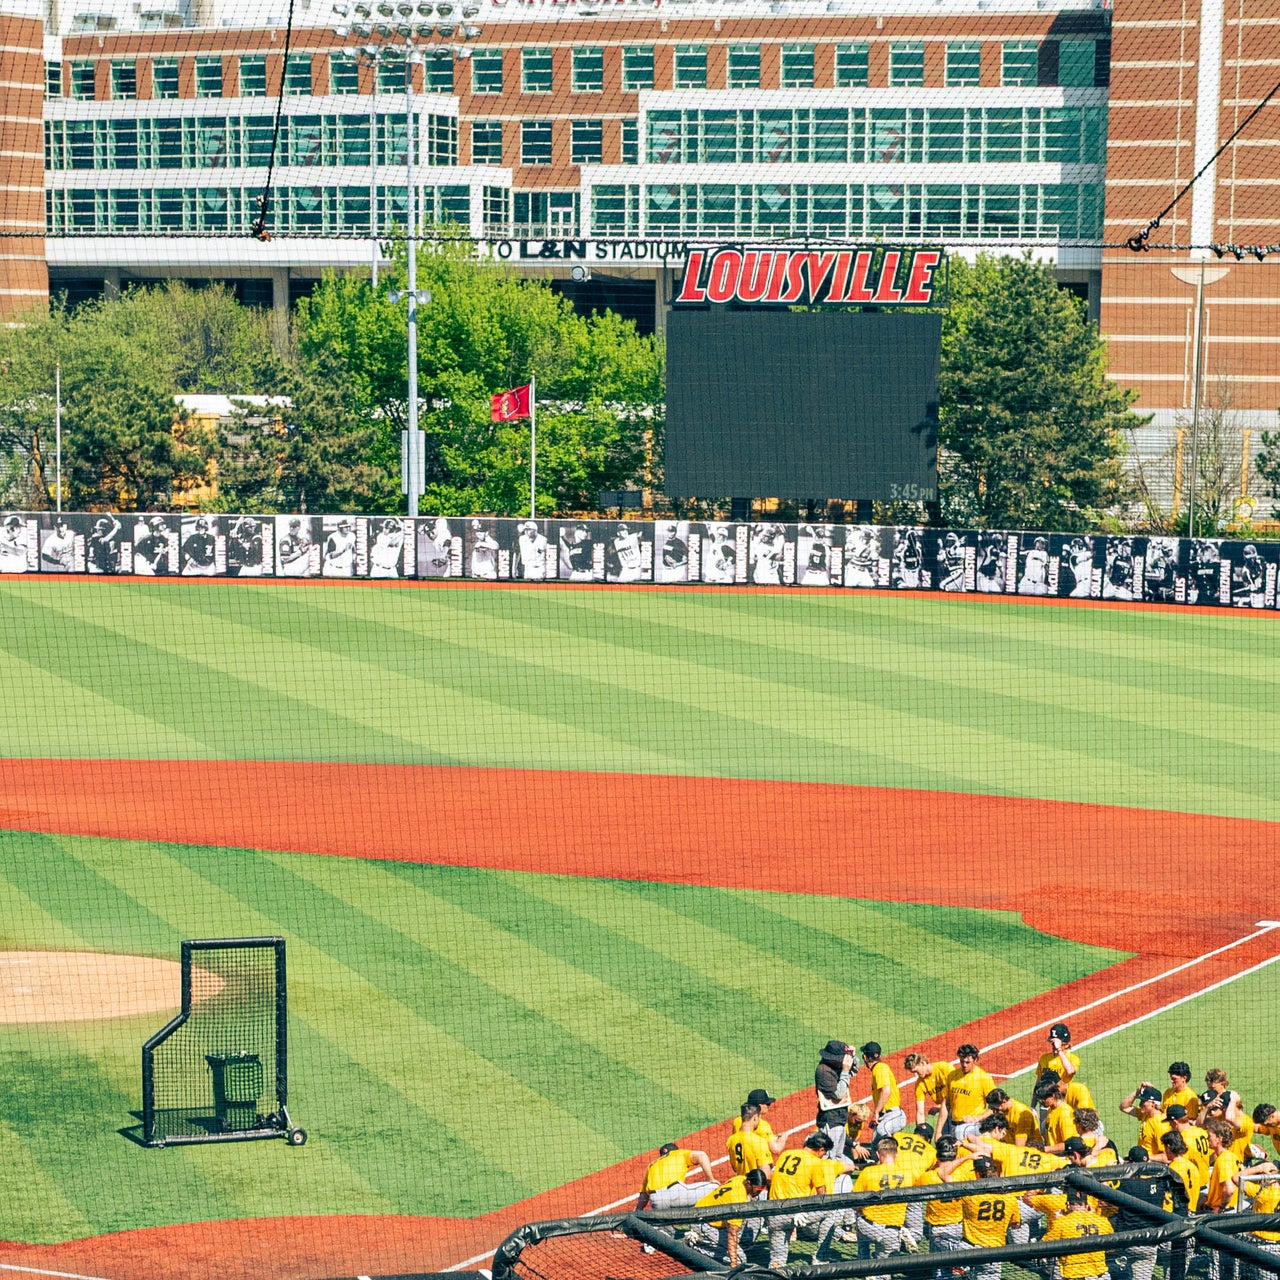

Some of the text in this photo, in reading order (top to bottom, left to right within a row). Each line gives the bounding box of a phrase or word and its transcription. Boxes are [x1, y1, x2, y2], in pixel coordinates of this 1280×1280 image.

[519, 239, 586, 258] L&N
[595, 241, 686, 259] STADIUM
[676, 250, 940, 303] LOUISVILLE
[451, 536, 462, 578] HOLLAND
[546, 544, 557, 579] WRIGHT
[687, 533, 700, 581] THOMPSON
[735, 525, 748, 584] FUNKHOUSER
[964, 546, 976, 591] HAIRSTON
[1006, 535, 1018, 593] HARRINGTON
[1048, 556, 1060, 595] McCLURE
[1091, 567, 1102, 598] SOLAK
[1131, 556, 1143, 600] BORDNER
[1175, 577, 1186, 602] ELLIS
[1265, 562, 1277, 606] STOWERS
[734, 1142, 743, 1164] 9
[899, 1136, 927, 1157] 32
[1195, 1135, 1209, 1158] 40
[778, 1154, 802, 1176] 13
[879, 1174, 905, 1190] 47
[977, 1200, 1006, 1223] 28
